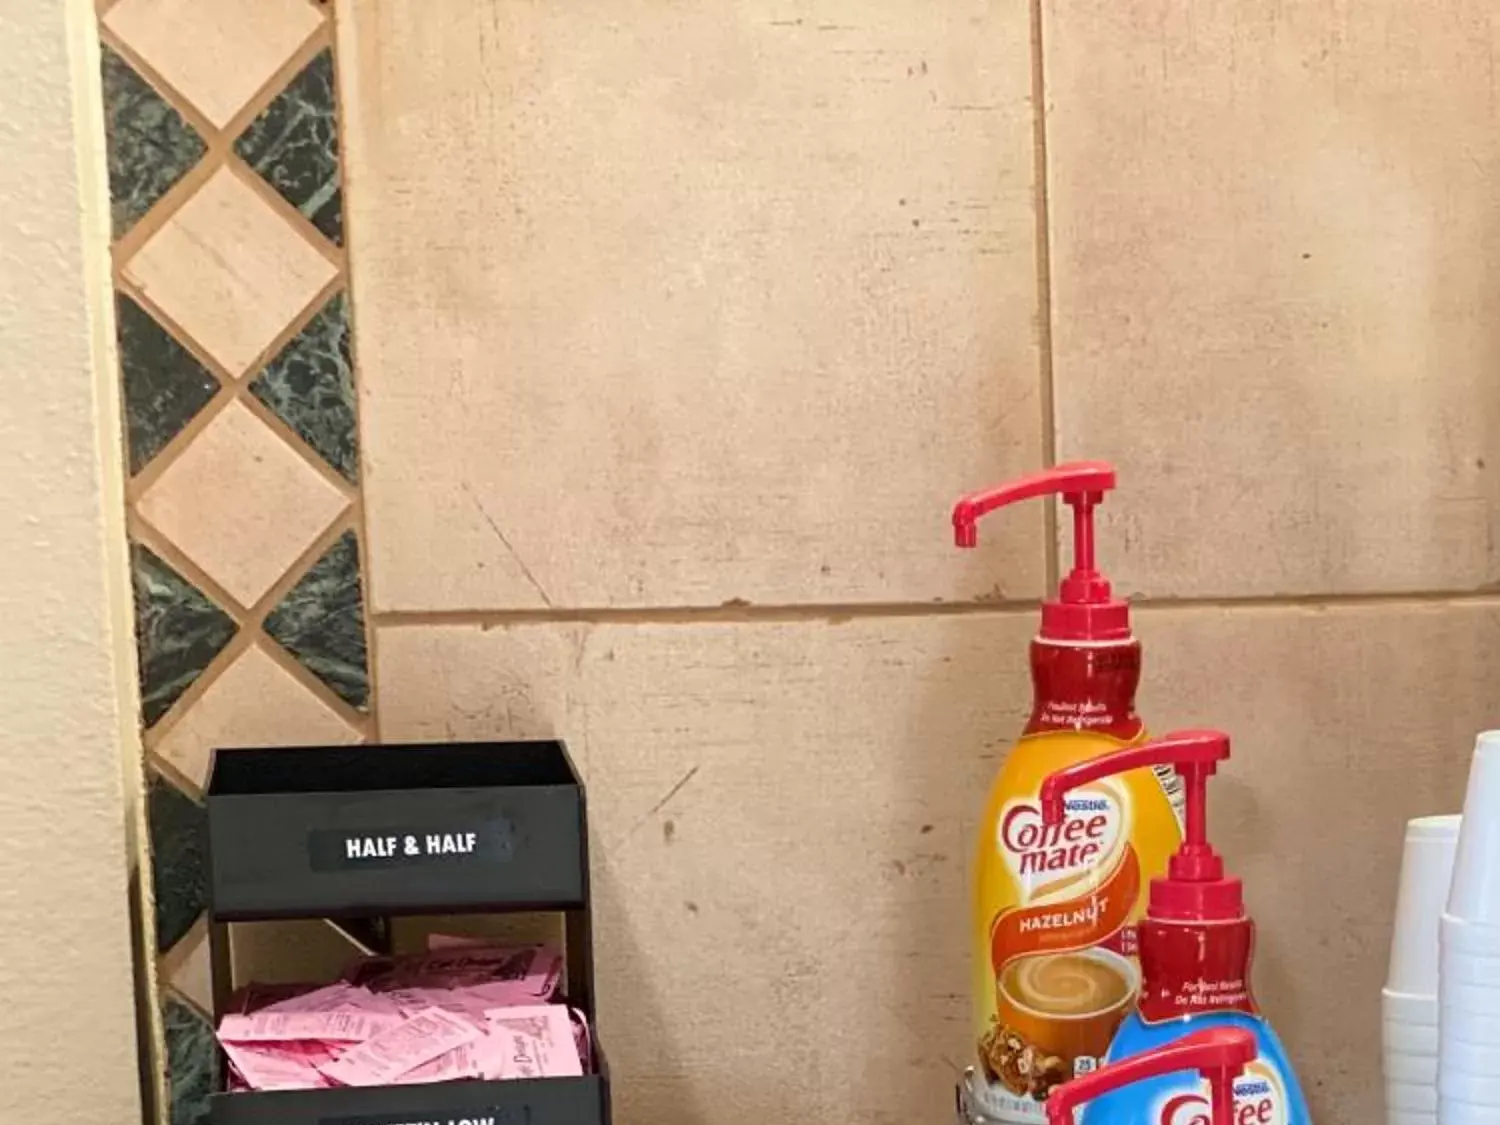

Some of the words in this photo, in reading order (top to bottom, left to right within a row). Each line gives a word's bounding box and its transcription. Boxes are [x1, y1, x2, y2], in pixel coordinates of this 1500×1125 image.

[345, 837, 397, 859] HALF
[404, 836, 419, 856] &
[426, 833, 477, 855] HALF
[1019, 842, 1100, 875] mate
[1019, 897, 1109, 933] HAZELNUT
